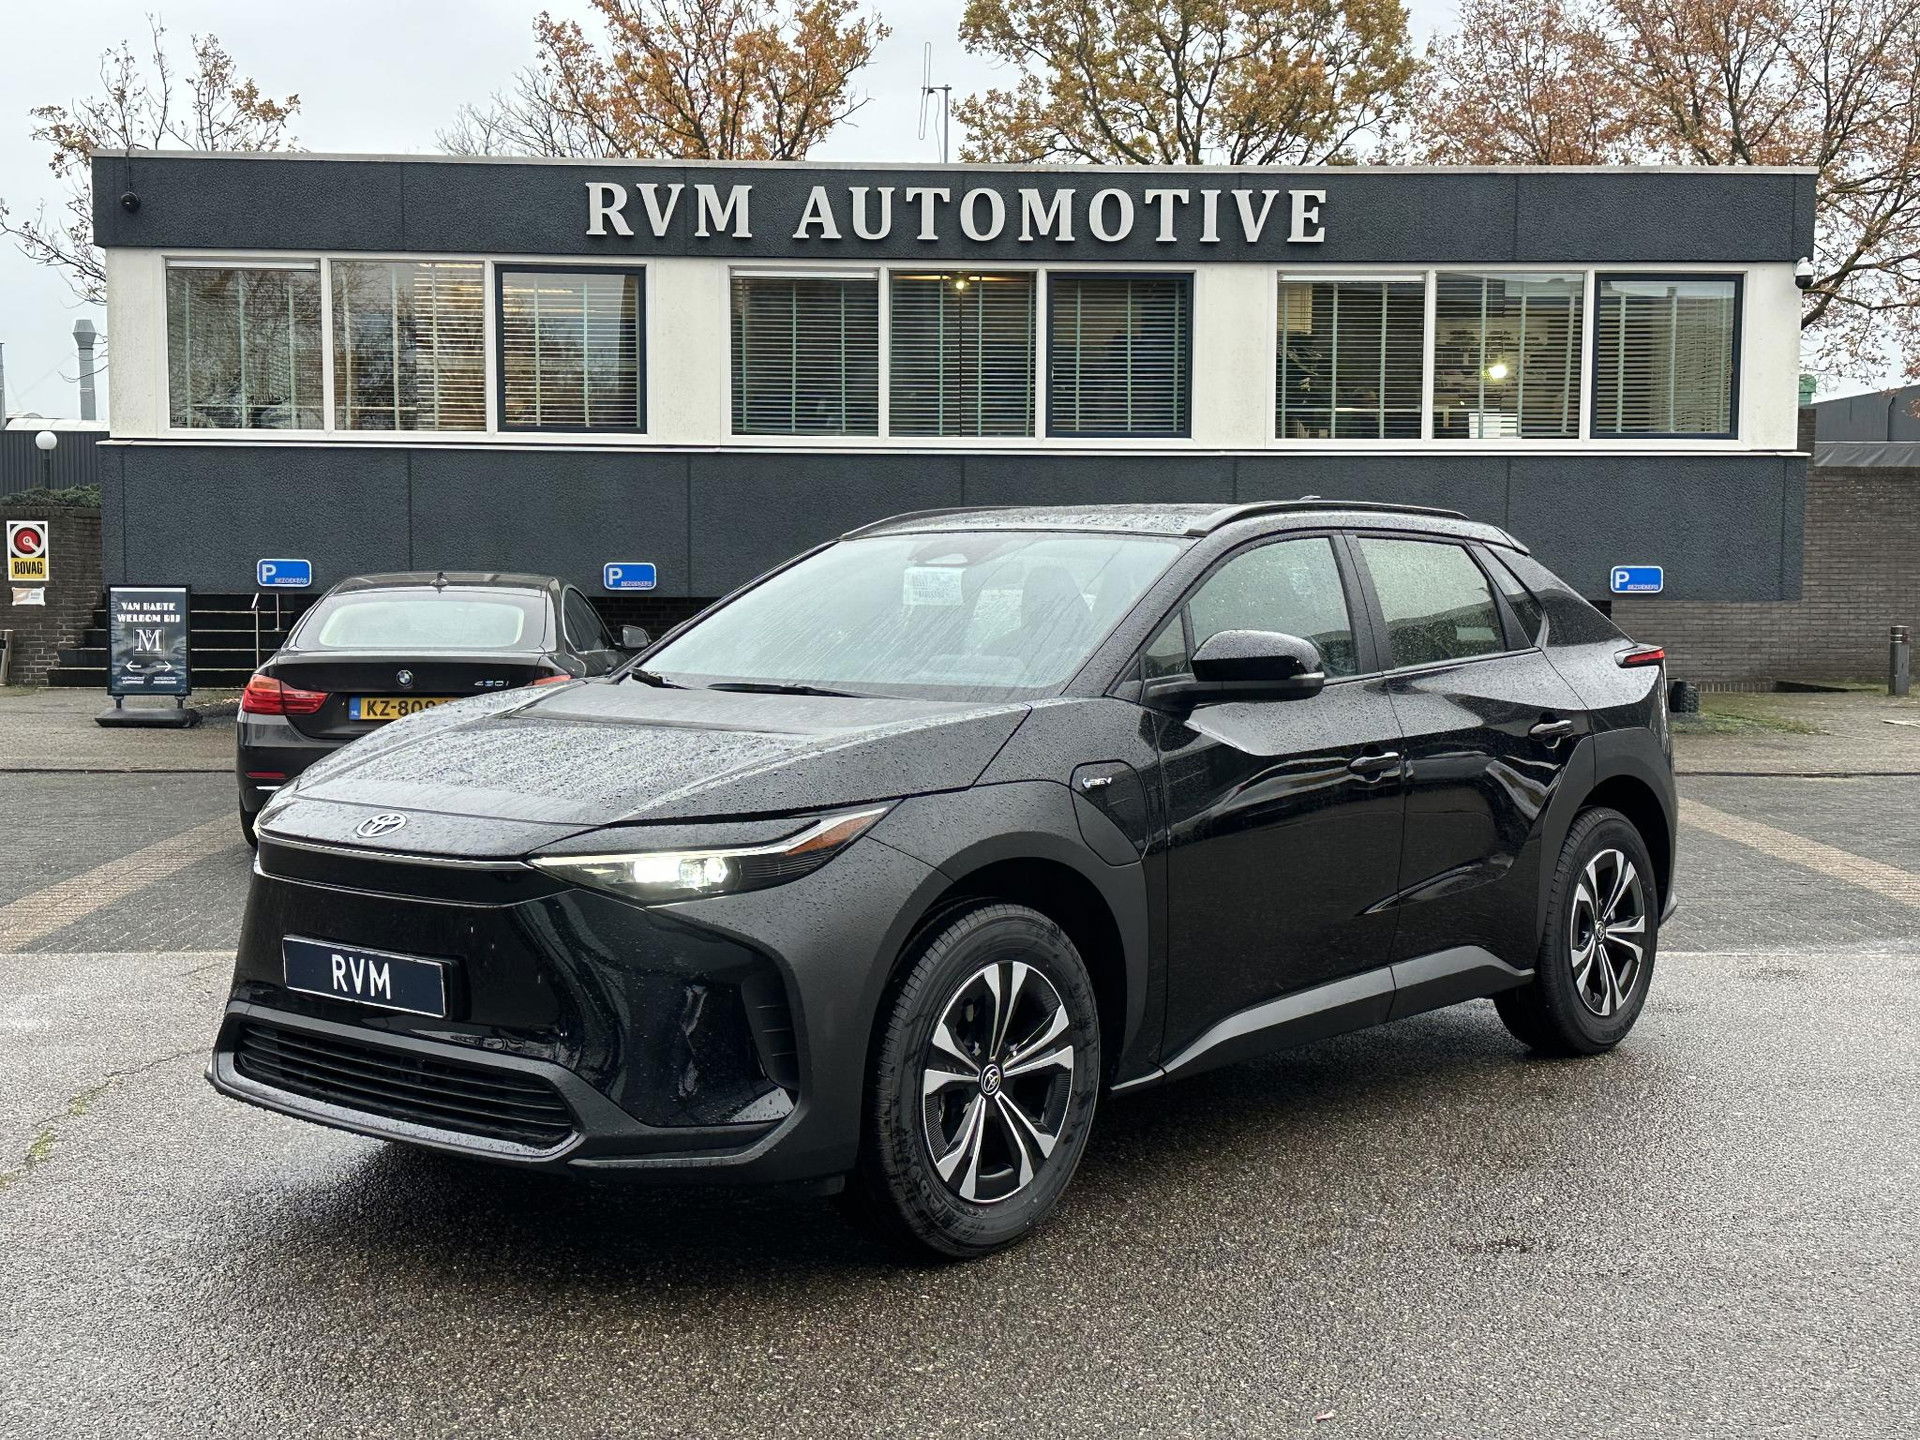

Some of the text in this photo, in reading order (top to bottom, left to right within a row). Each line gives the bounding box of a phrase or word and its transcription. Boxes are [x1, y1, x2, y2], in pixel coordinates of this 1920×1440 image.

[586, 182, 1326, 242] RVM AUTOMOTIVE
[14, 561, 43, 575] BOVAG
[262, 564, 277, 582] P
[608, 567, 623, 585] P
[1615, 570, 1630, 589] P
[121, 602, 176, 611] VAN HARTE
[331, 953, 391, 1000] RVM
